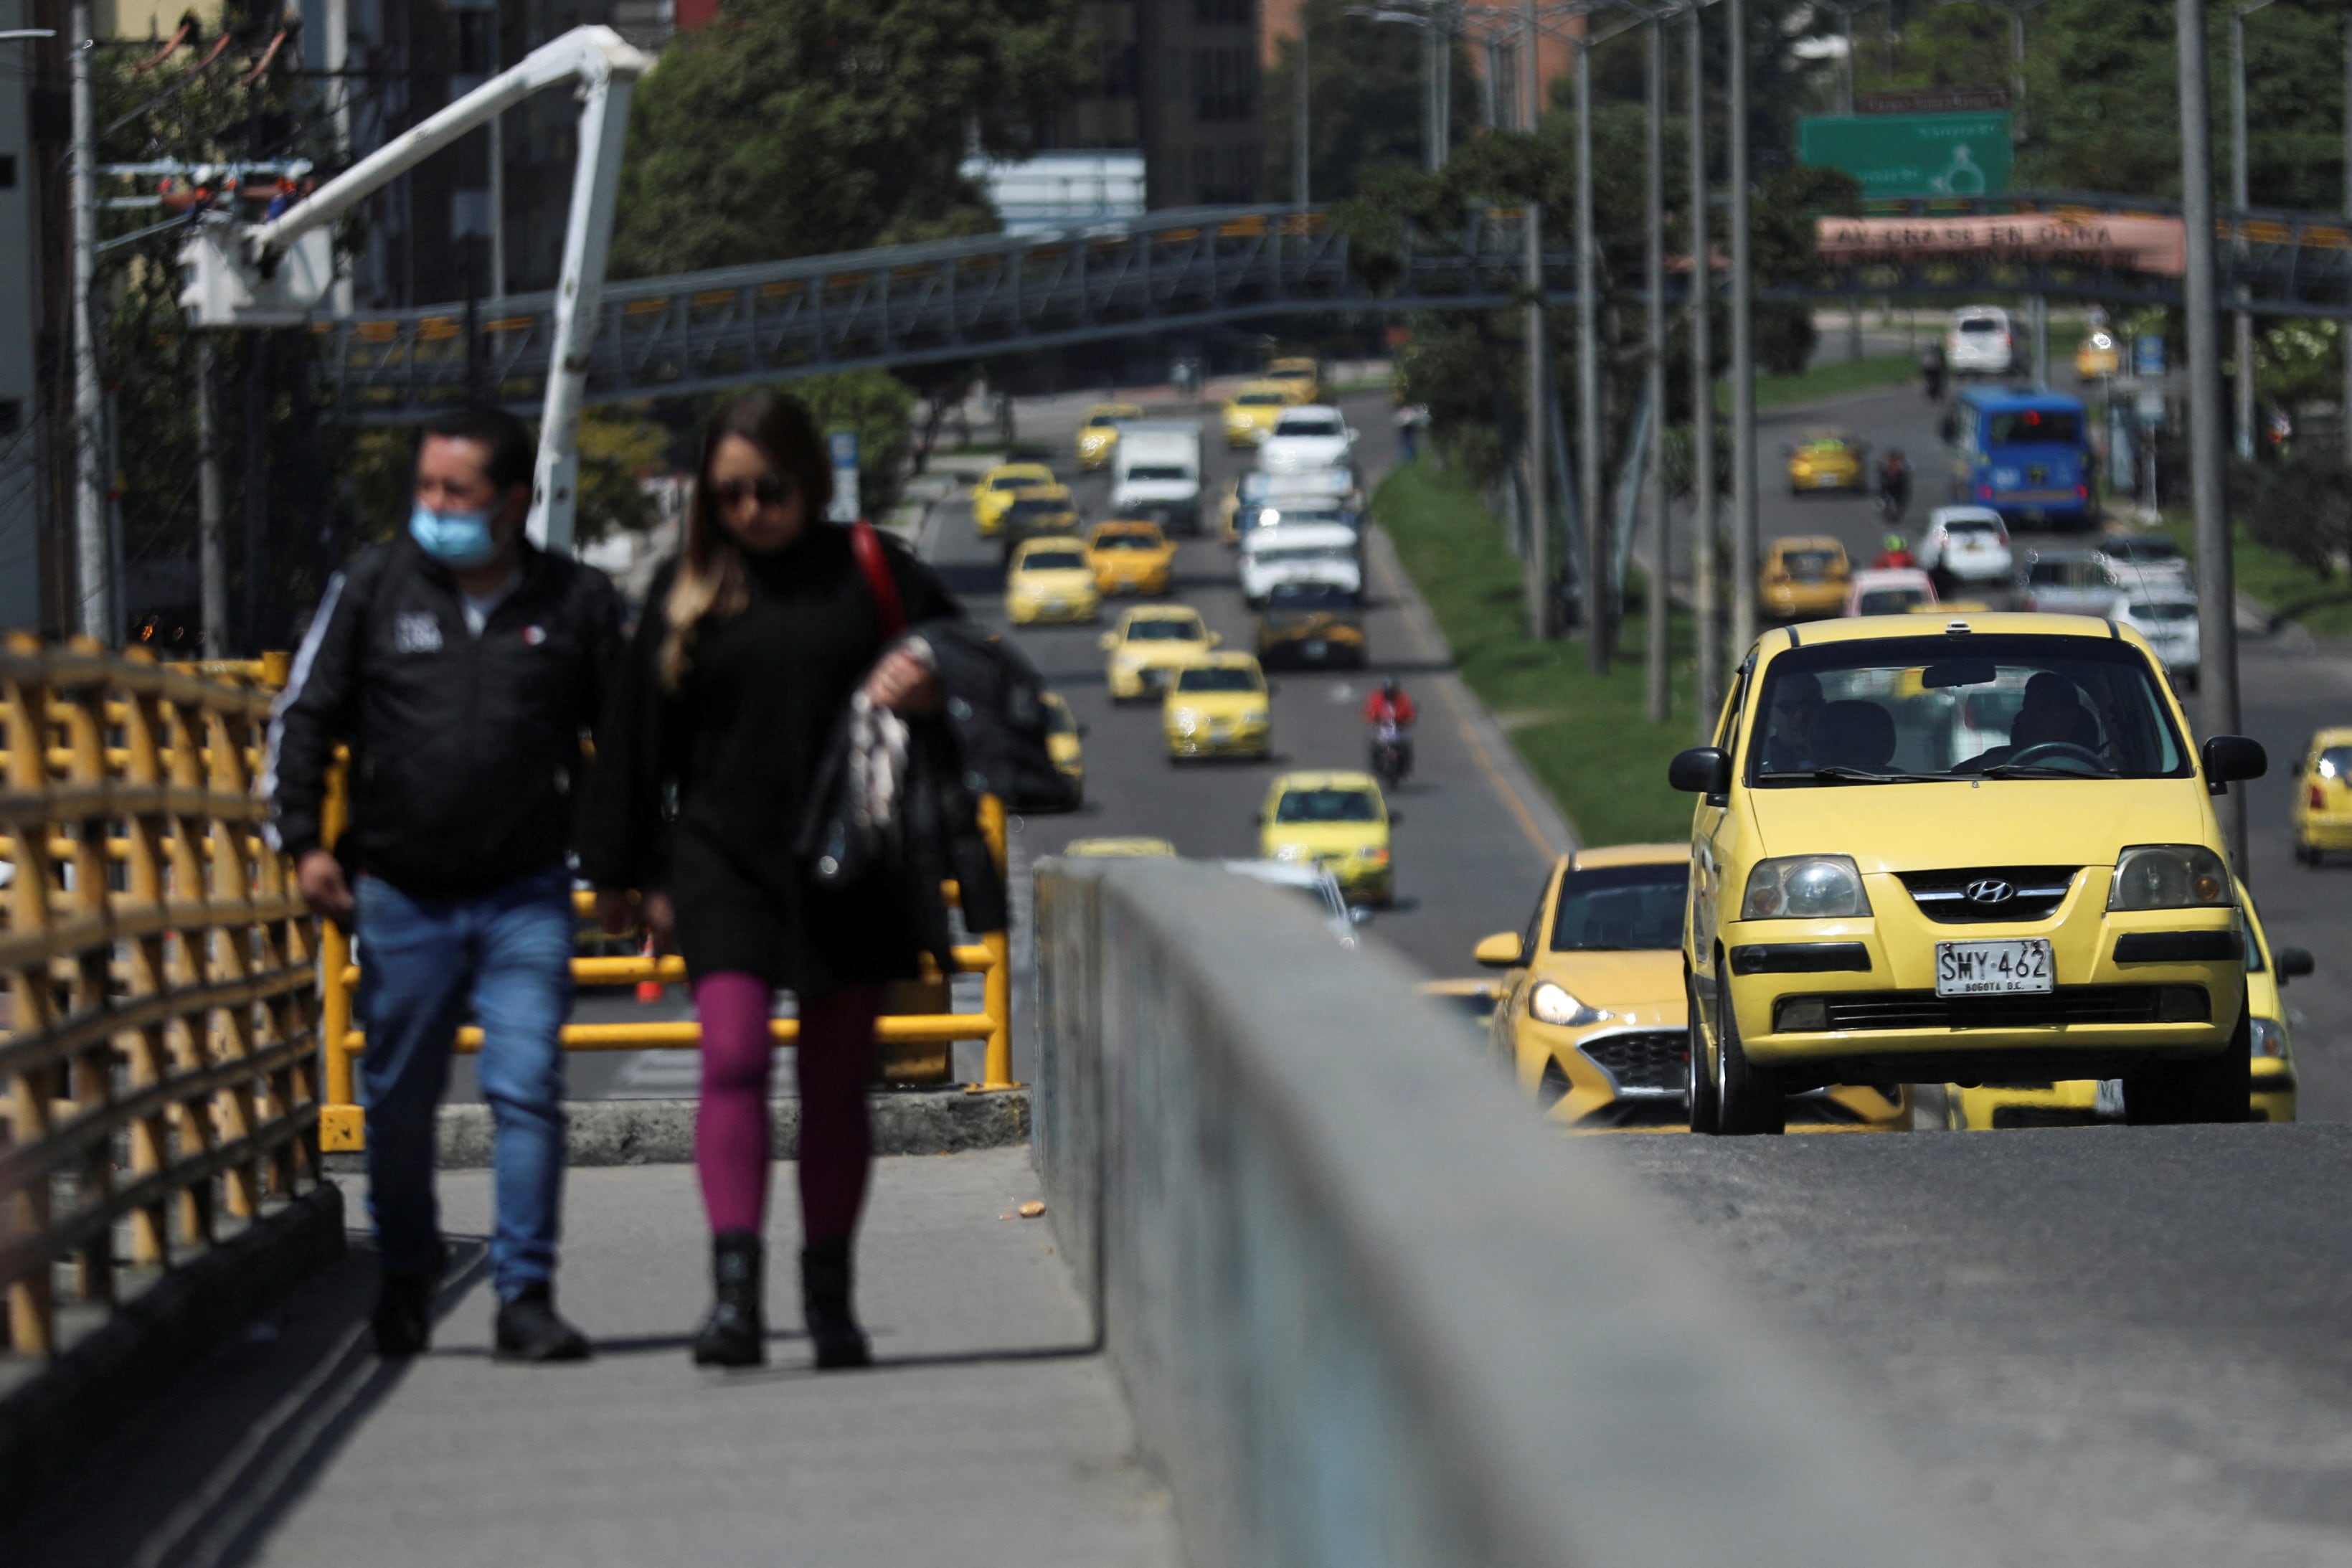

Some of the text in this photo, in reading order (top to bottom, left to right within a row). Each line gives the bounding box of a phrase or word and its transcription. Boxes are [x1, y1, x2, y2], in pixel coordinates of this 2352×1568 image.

[1941, 948, 2047, 981] SMY 462
[1965, 981, 2024, 991] BOGOTA D.C.
